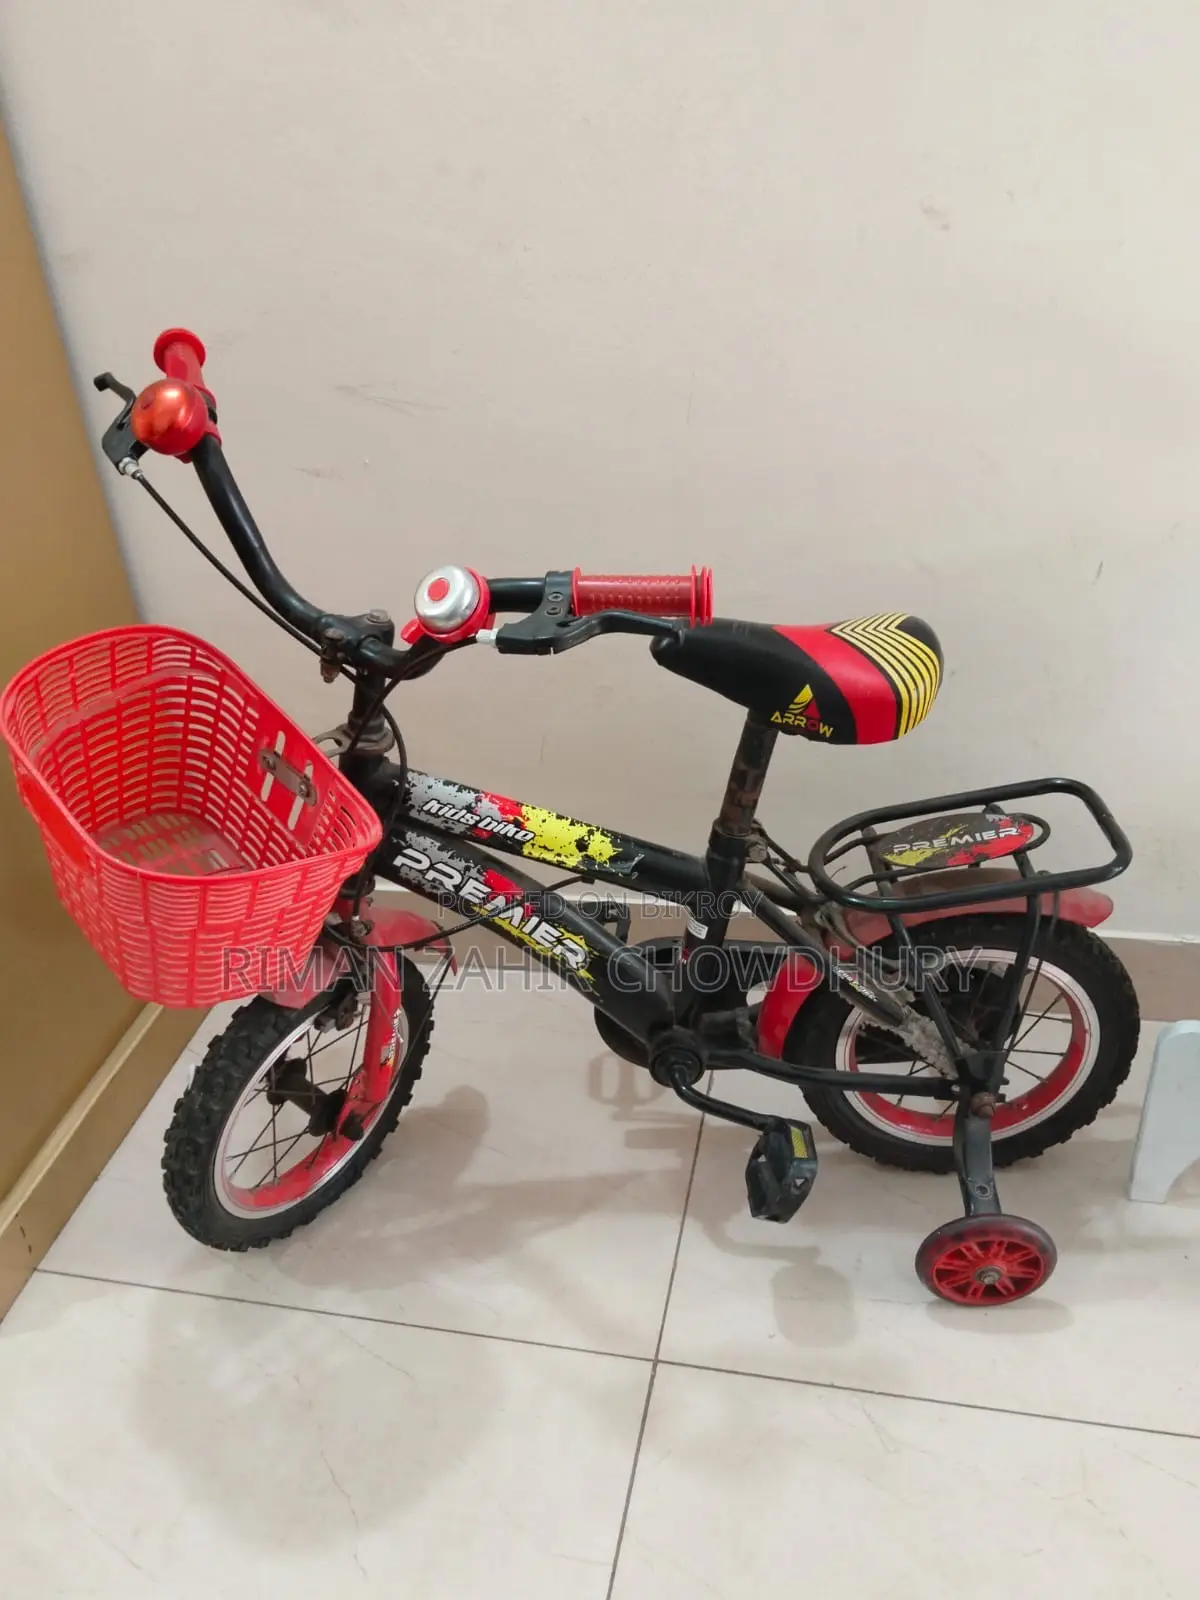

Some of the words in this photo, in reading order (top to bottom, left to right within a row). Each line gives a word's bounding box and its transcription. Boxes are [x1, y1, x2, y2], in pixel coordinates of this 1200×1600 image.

[770, 710, 833, 738] ARROW
[893, 827, 1021, 854] PREMIER
[392, 848, 588, 970] PREMIER
